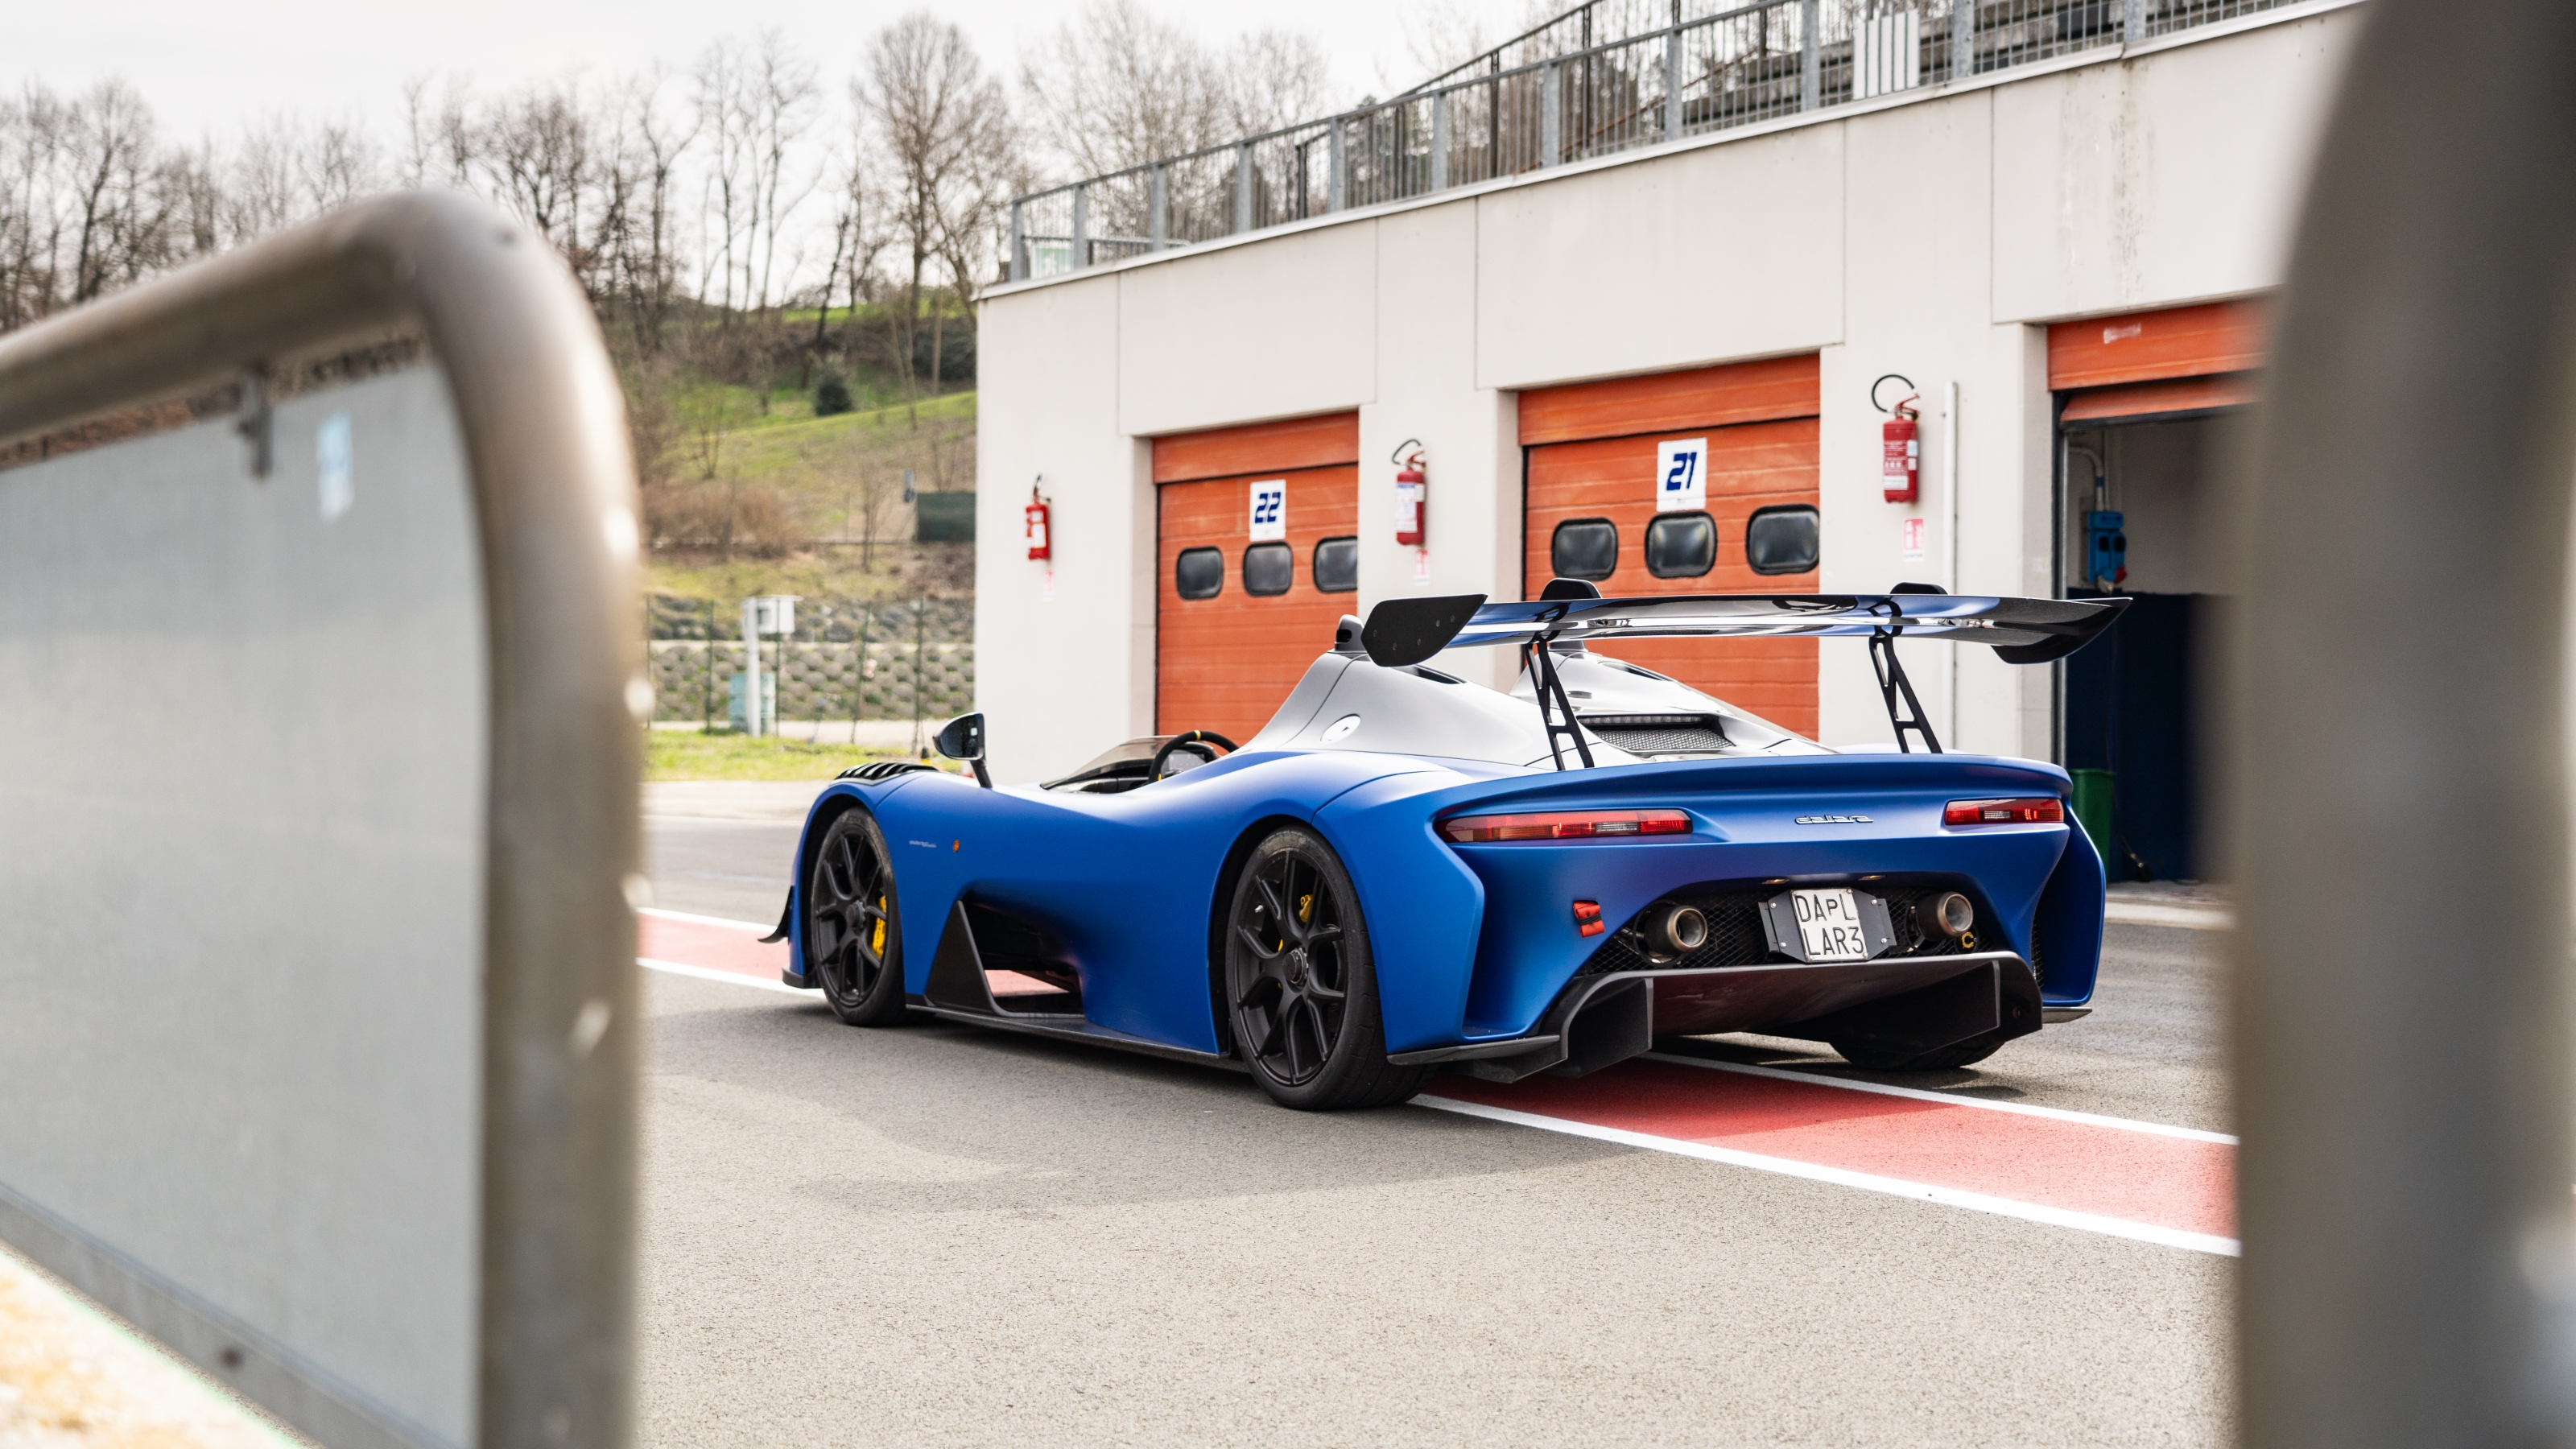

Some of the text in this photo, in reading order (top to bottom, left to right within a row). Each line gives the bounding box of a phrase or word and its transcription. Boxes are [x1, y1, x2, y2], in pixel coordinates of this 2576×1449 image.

[1666, 452, 1697, 491] 21
[1254, 492, 1281, 523] 22
[1803, 927, 1864, 956] LAR3
